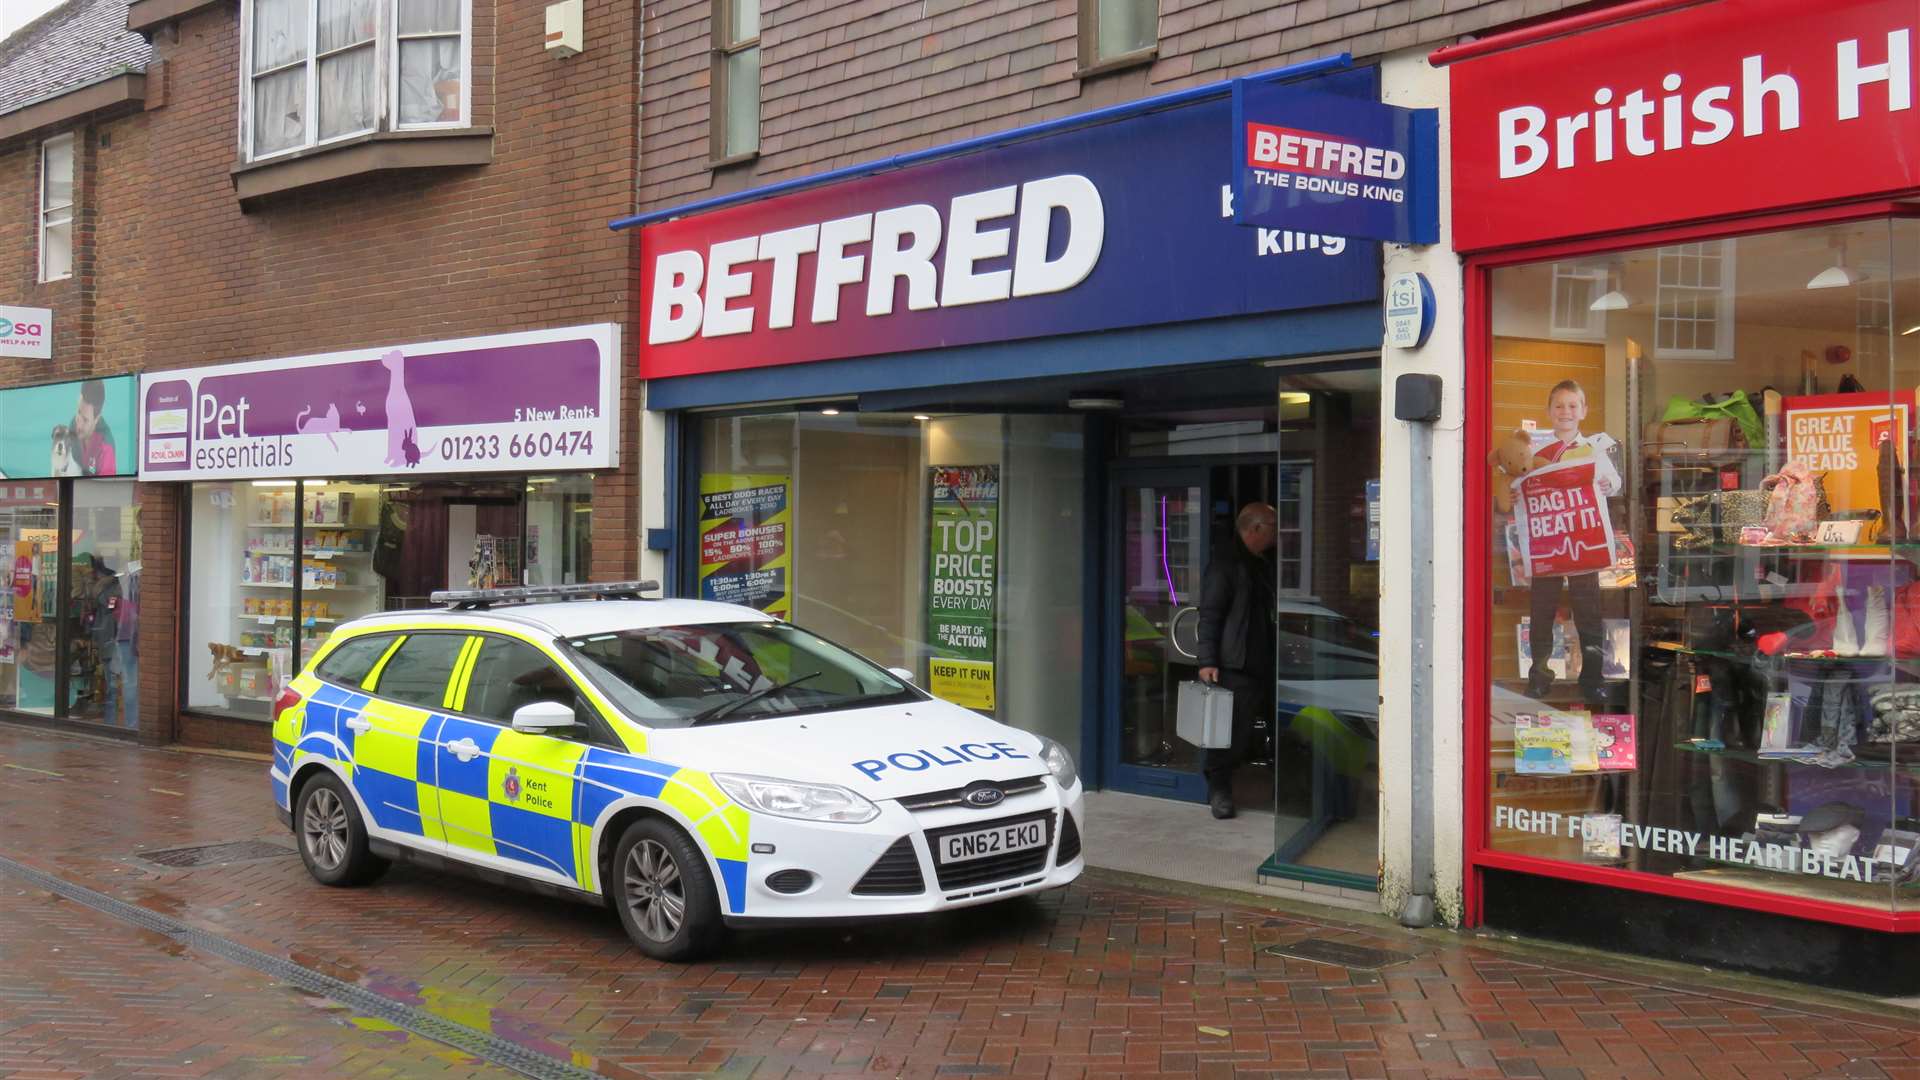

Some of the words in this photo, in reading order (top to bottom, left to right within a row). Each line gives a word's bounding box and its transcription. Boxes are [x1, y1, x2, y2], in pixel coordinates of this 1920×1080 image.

[1499, 54, 1800, 180] British
[1837, 28, 1911, 121] H
[1254, 130, 1406, 181] BETFRED
[1254, 170, 1290, 188] THE
[1295, 176, 1358, 197] BONUS
[1363, 185, 1404, 203] KING
[648, 174, 1105, 346] BETFRED
[1392, 287, 1415, 307] tsi
[200, 393, 249, 440] Pet
[513, 408, 522, 422] 5
[526, 407, 555, 422] New
[559, 404, 595, 420] Rents
[1795, 415, 1855, 435] GREAT
[196, 435, 293, 470] essentials
[441, 434, 500, 461] 01233
[509, 430, 593, 458] 660474
[1795, 434, 1853, 453] VALUE
[709, 502, 724, 510] ALL
[725, 499, 740, 508] DAY
[740, 496, 766, 506] EVERY
[767, 494, 782, 503] DAY
[712, 492, 734, 502] BEST
[734, 489, 758, 499] ODDS
[758, 486, 784, 496] RACES
[1528, 491, 1565, 514] BAG
[1567, 487, 1588, 509] IT.
[1530, 511, 1577, 539] BEAT
[1580, 507, 1601, 530] IT.
[704, 531, 736, 543] SUPER
[738, 524, 784, 538] BONUSES
[937, 521, 993, 553] TOP
[704, 548, 722, 557] 15%
[730, 544, 751, 554] 50%
[759, 540, 783, 549] 100%
[935, 553, 993, 578] PRICE
[713, 583, 739, 592] 5:00PM
[933, 578, 993, 597] BOOSTS
[933, 595, 968, 609] EVERY
[971, 597, 992, 610] DAY
[939, 624, 950, 633] BE
[951, 624, 972, 635] PART
[973, 626, 985, 636] OF
[948, 635, 987, 648] ACTION
[933, 665, 957, 678] KEEP
[959, 668, 968, 679] IT
[971, 669, 990, 681] FUN
[851, 742, 1031, 782] POLICE
[526, 778, 547, 792] Kent
[526, 794, 553, 809] Police
[949, 832, 1000, 859] GN62
[1005, 824, 1039, 849] EKO
[1495, 805, 1561, 836] FIGHT
[1620, 824, 1701, 857] EVERY
[1709, 835, 1881, 883] HEARTBEAT
